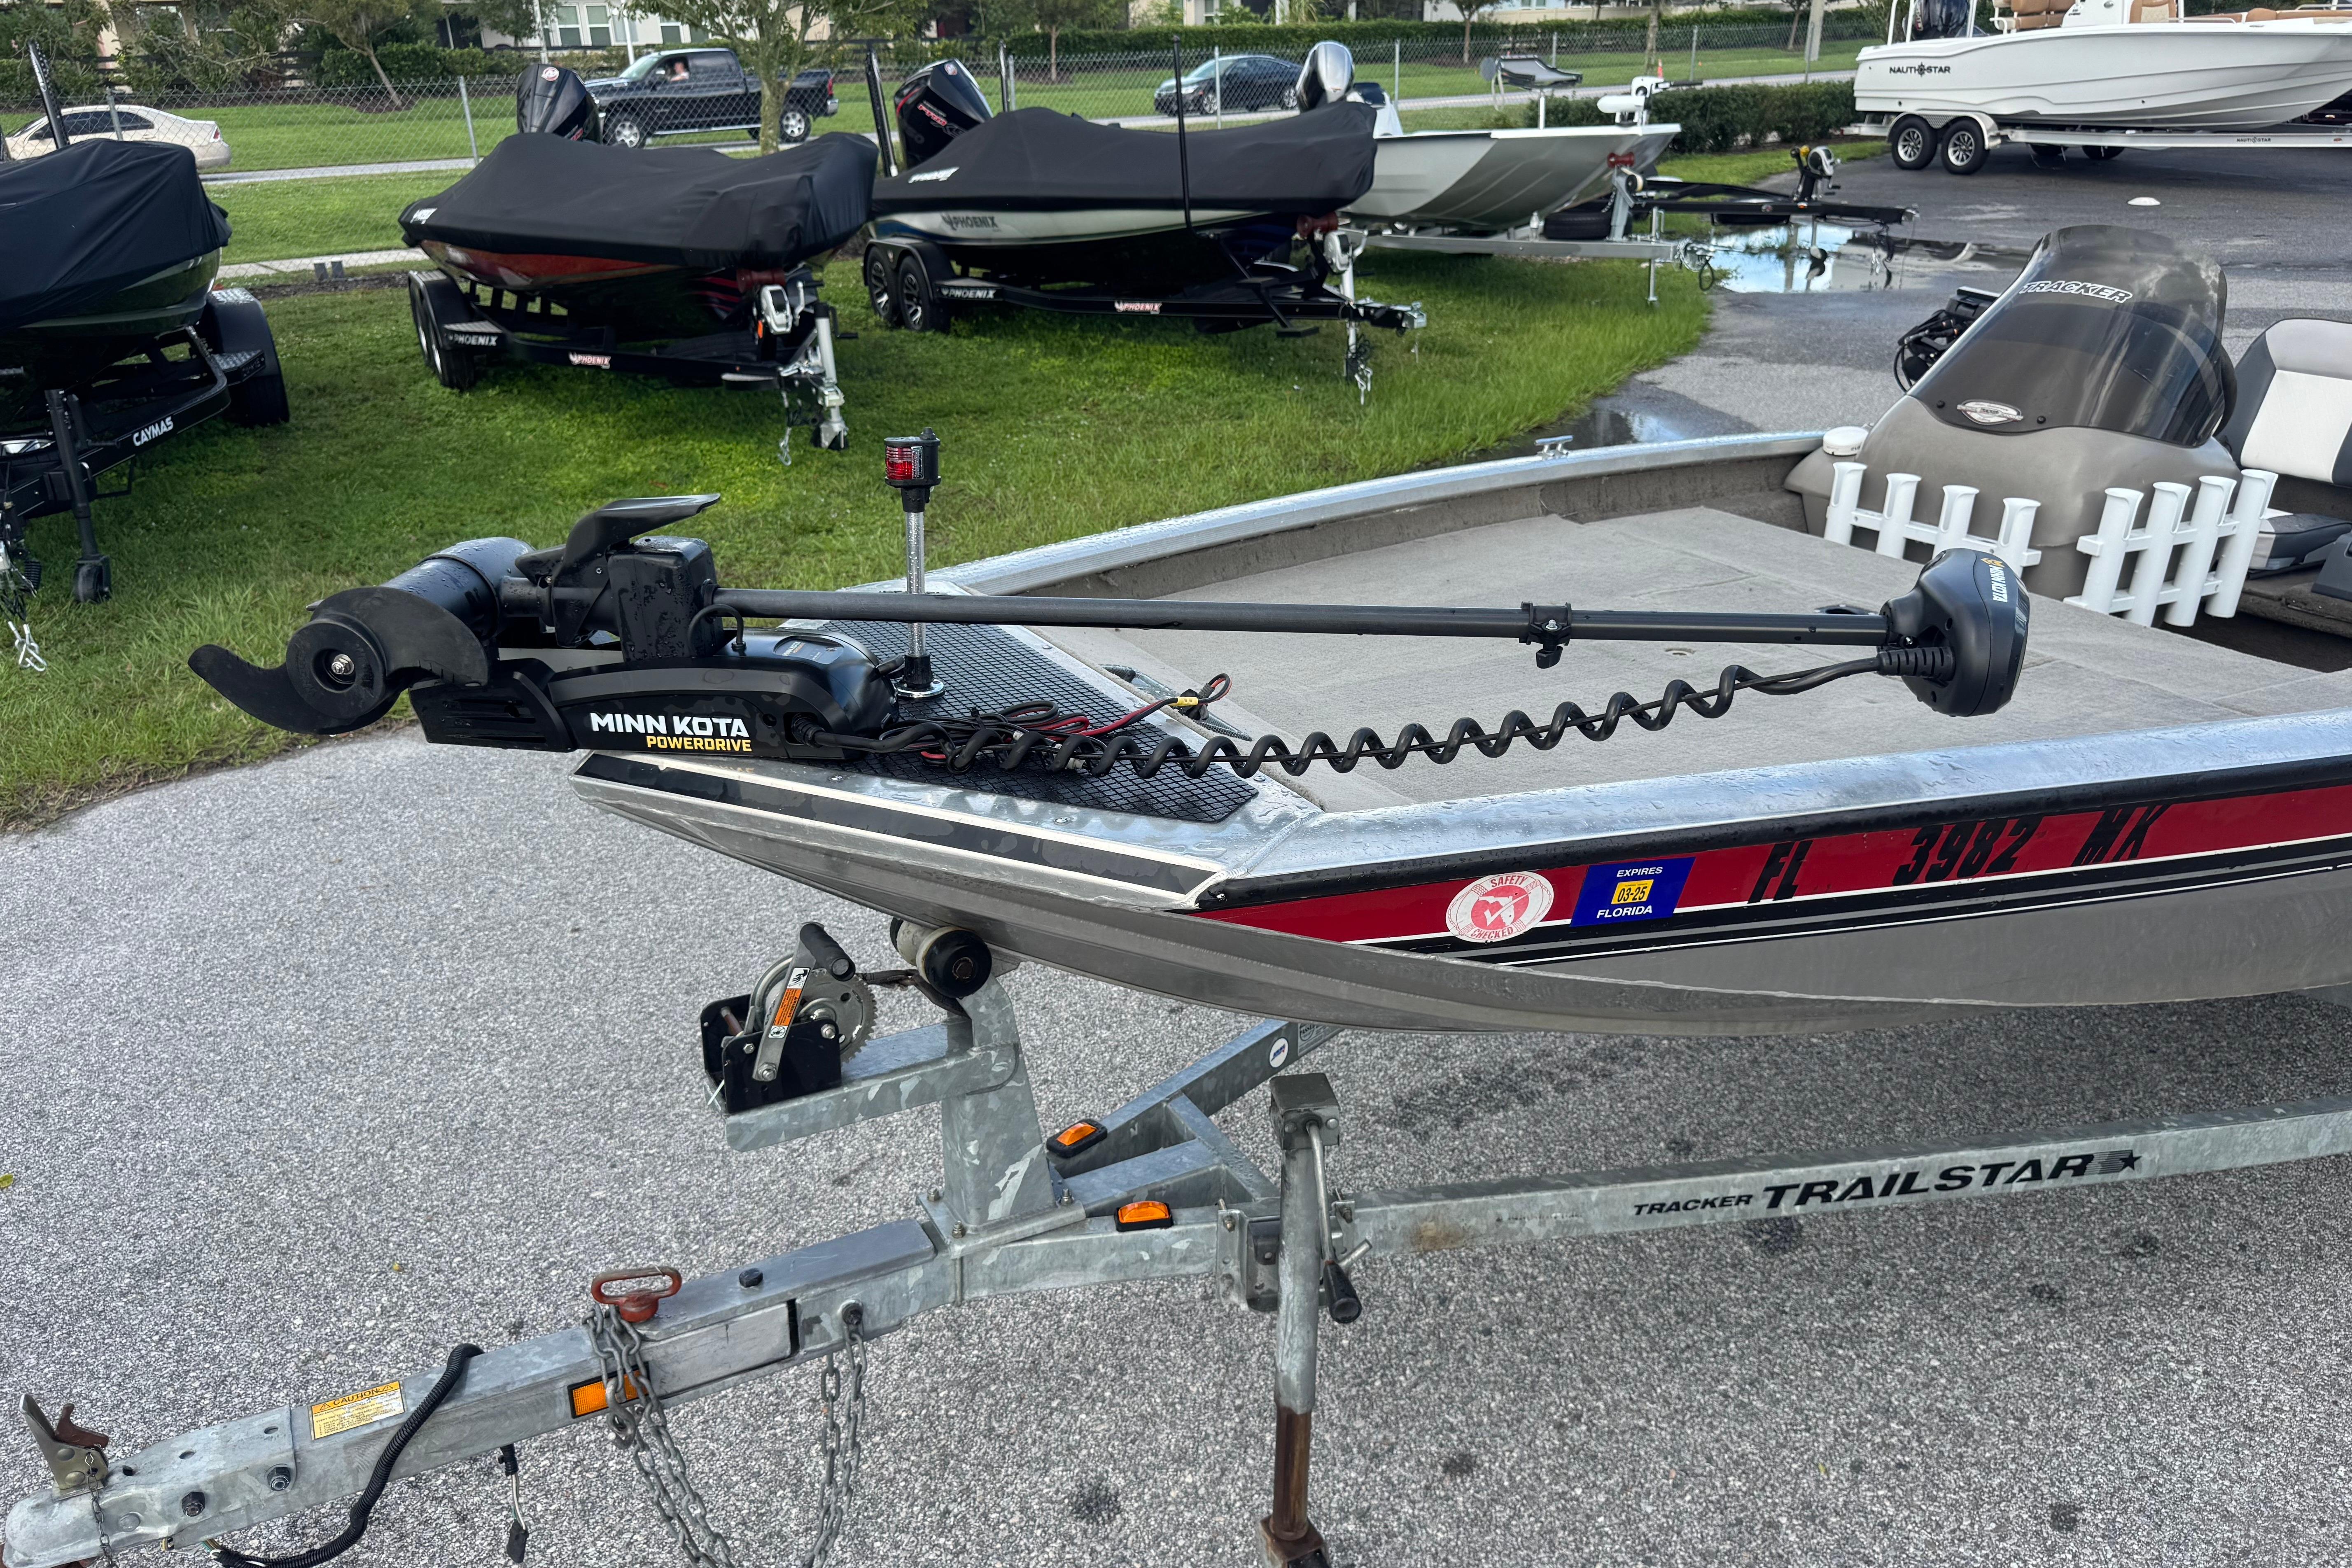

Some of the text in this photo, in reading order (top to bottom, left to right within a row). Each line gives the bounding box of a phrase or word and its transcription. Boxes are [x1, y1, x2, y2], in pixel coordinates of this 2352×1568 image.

[952, 216, 998, 228] PHOENIX
[948, 289, 996, 299] PHOENIX
[2018, 280, 2133, 303] TRACKER
[453, 333, 498, 346] PHOENIX
[576, 354, 611, 365] PHOENIX
[133, 416, 174, 447] CAYMAS
[1988, 564, 2008, 603] MINN KOTA
[590, 712, 750, 737] MINN KOTA
[646, 735, 752, 752] POWERDRIVE
[1747, 803, 2173, 904] FL 3982 MK
[1616, 866, 1663, 877] EXPIRES
[1490, 875, 1528, 888] SAFETY
[1617, 886, 1647, 902] 03-25
[1596, 905, 1653, 919] FLORIDA
[1470, 926, 1514, 939] CHECKED
[1633, 1153, 2095, 1215] TRACKER TRAILSTAR
[333, 1388, 379, 1405] CAUTION
